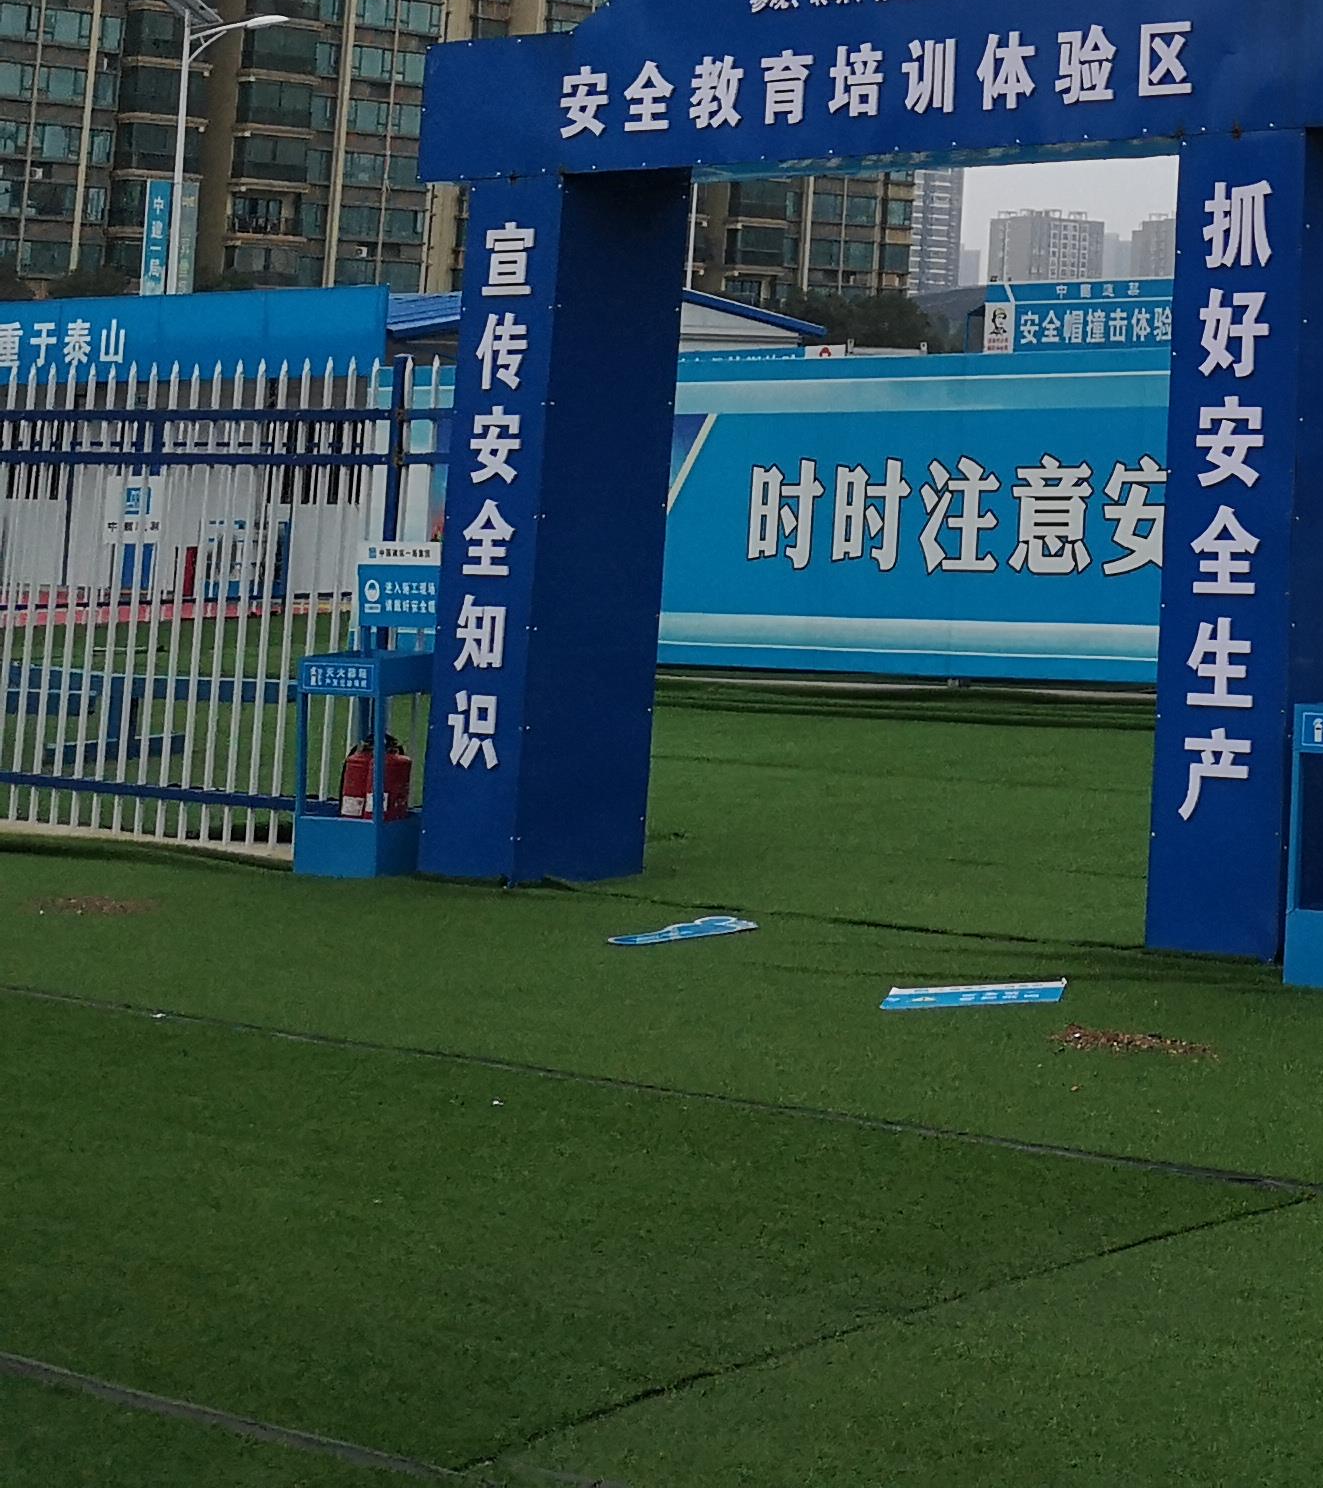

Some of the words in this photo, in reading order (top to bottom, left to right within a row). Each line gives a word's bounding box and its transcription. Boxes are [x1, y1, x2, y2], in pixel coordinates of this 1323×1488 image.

[558, 19, 1194, 139] 安全教育培训体验区
[0, 318, 125, 368] 重于泰山
[1019, 306, 1173, 345] 安全帽撞击体验
[446, 220, 536, 771] 宣传安全知识
[746, 453, 1167, 578] 时时注意安
[1177, 179, 1274, 821] 抓好安全生产
